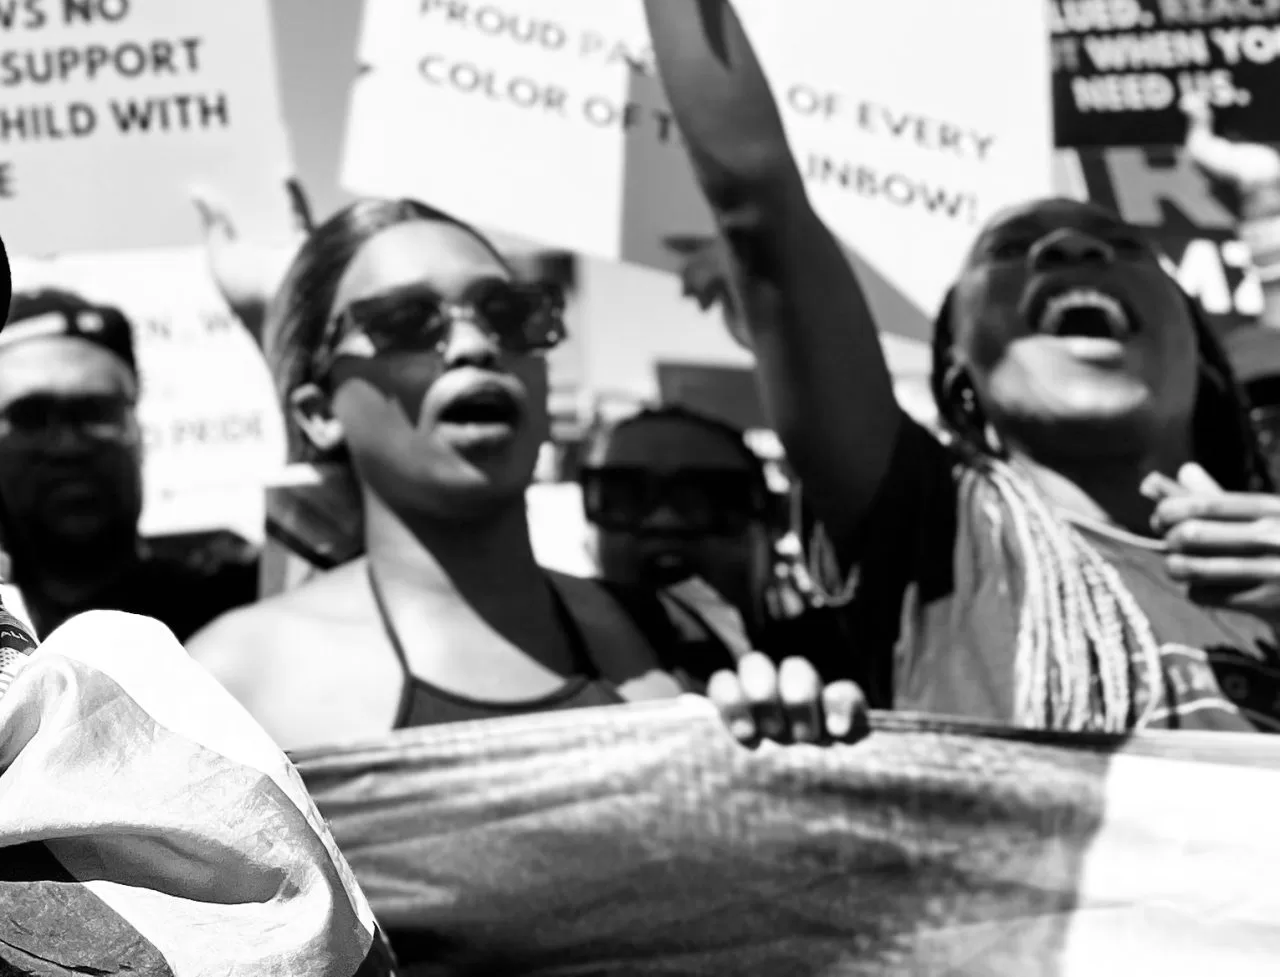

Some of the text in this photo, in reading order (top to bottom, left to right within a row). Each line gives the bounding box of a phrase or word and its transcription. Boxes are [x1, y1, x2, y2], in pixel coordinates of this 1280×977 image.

[107, 88, 231, 135] WITH
[417, 52, 571, 120] COLOR
[1072, 70, 1176, 113] NEED
[786, 81, 996, 164] OF EVERY
[807, 152, 978, 226] INBOW!
